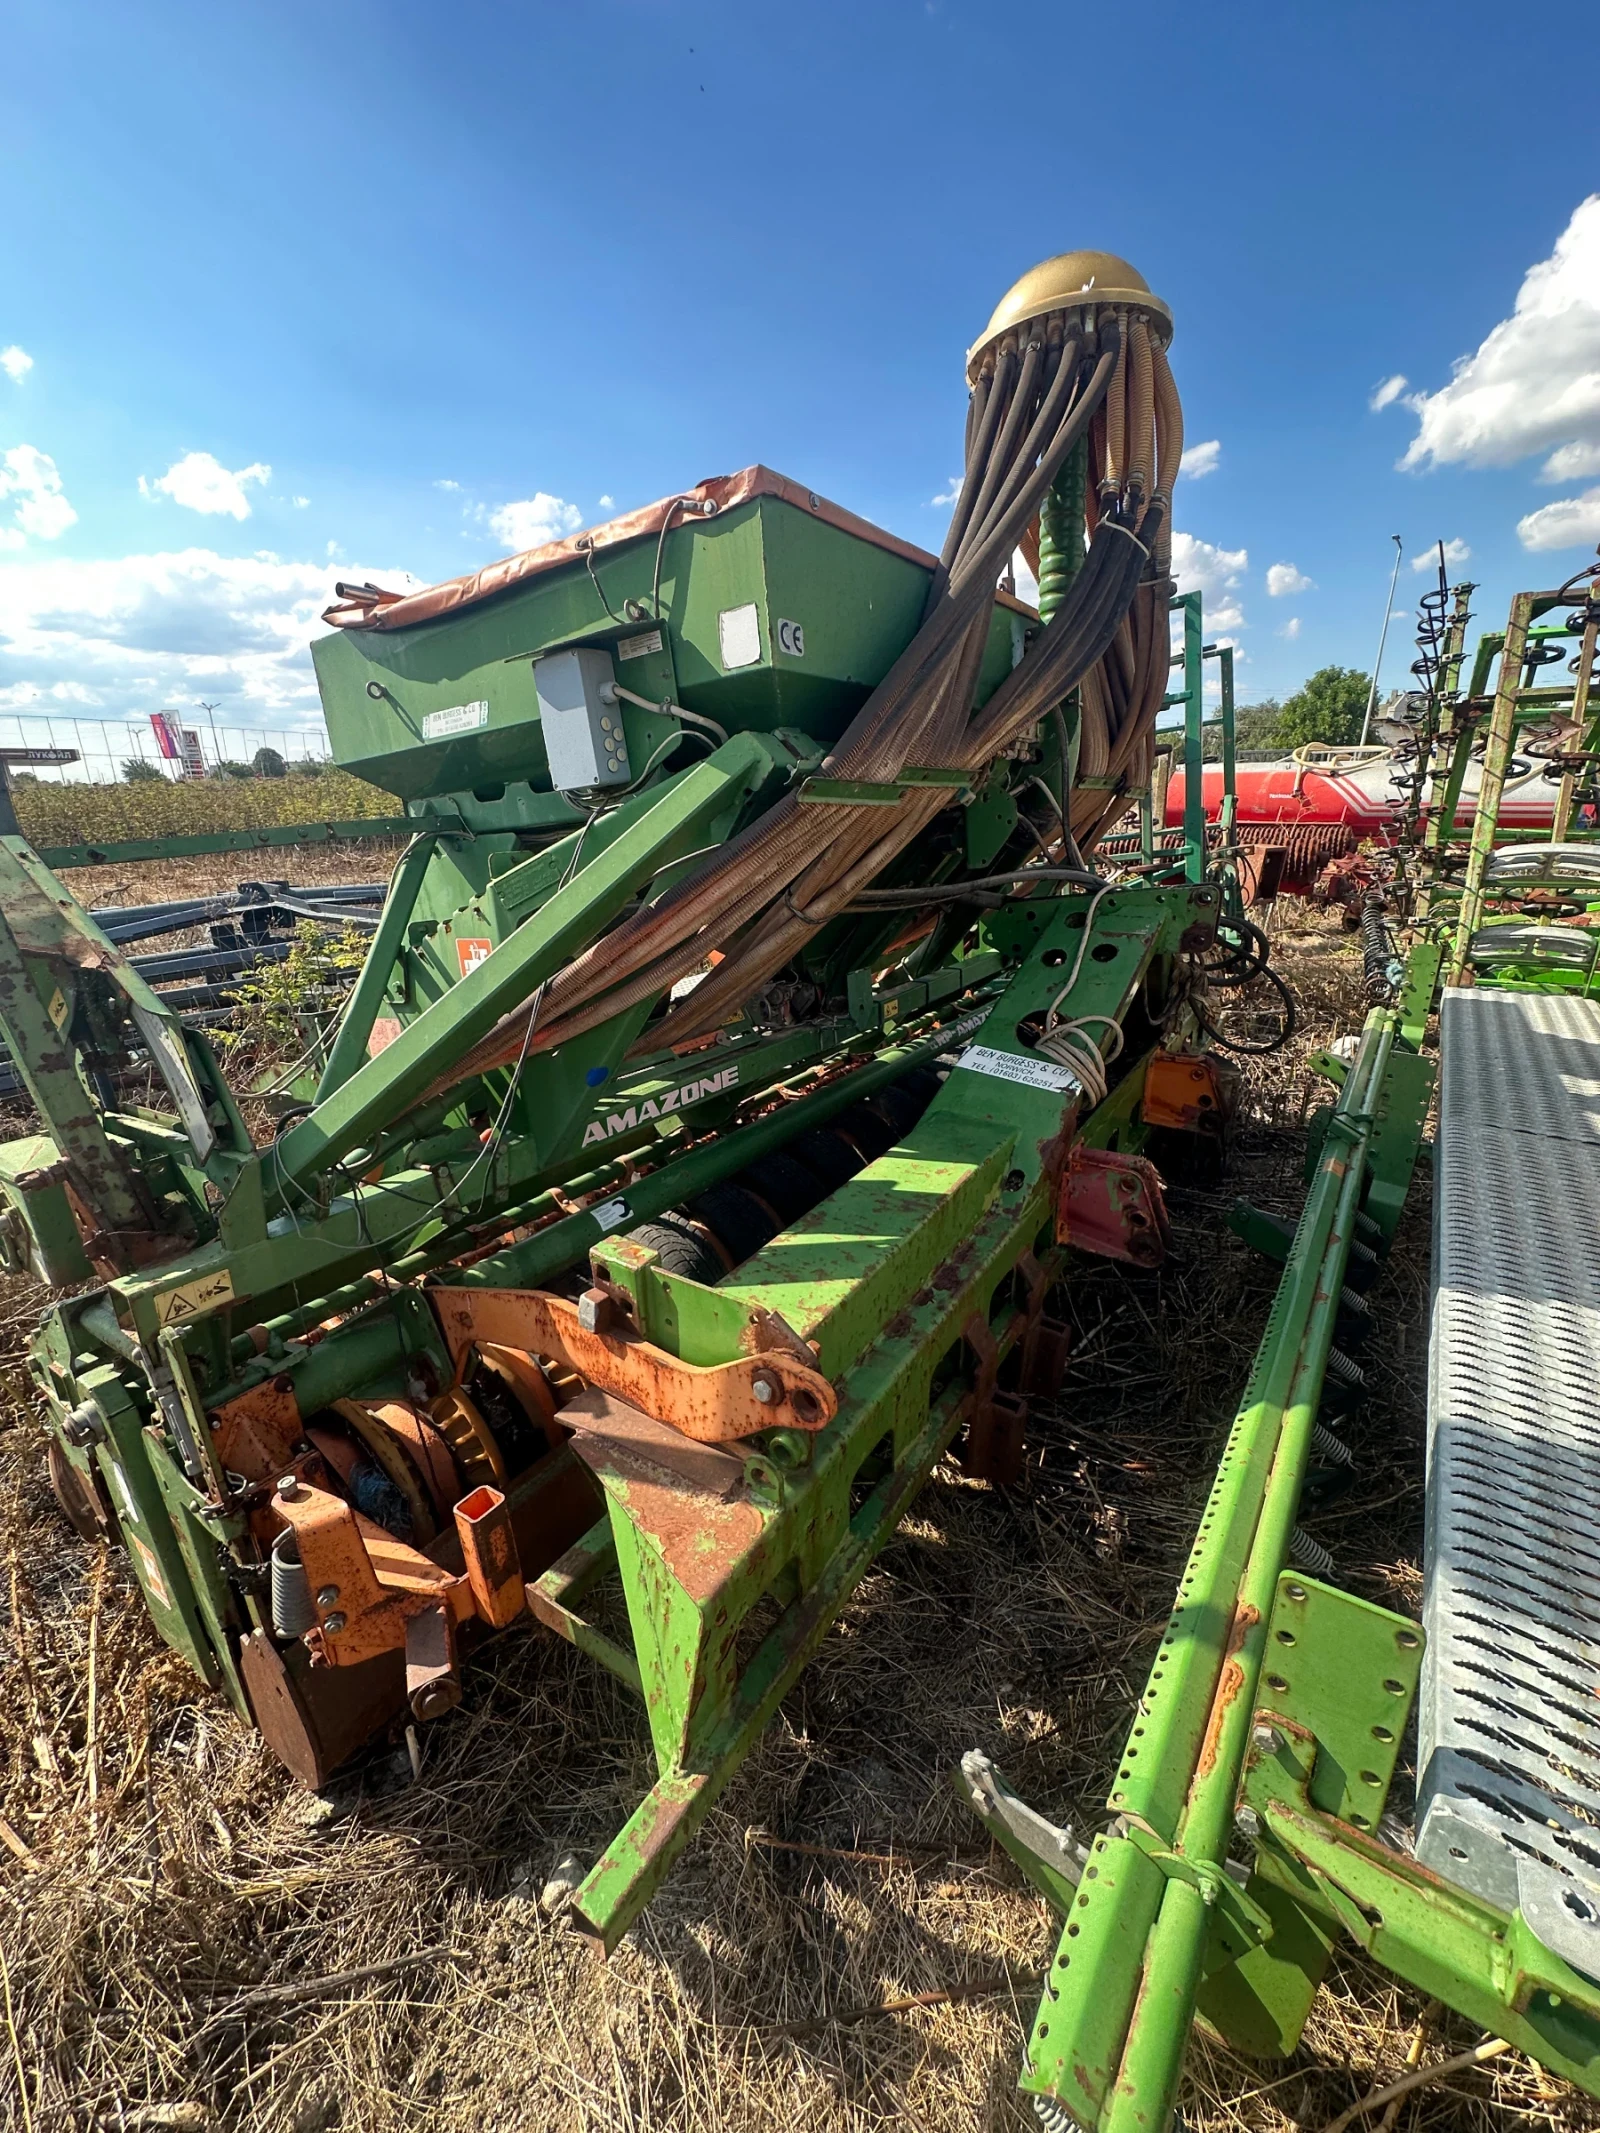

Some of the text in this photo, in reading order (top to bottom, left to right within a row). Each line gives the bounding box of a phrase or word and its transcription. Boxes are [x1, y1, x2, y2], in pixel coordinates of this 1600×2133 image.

[780, 622, 803, 654] CE
[27, 750, 72, 759] ЛУКОЙЛ
[976, 1048, 997, 1058] BEN
[996, 1053, 1039, 1069] BURGESS
[1040, 1064, 1049, 1072] &
[995, 1062, 1035, 1076] NORWICH
[989, 1065, 1021, 1080] (01603)
[1022, 1075, 1053, 1088] 628251
[582, 1065, 739, 1149] AMAZONE
